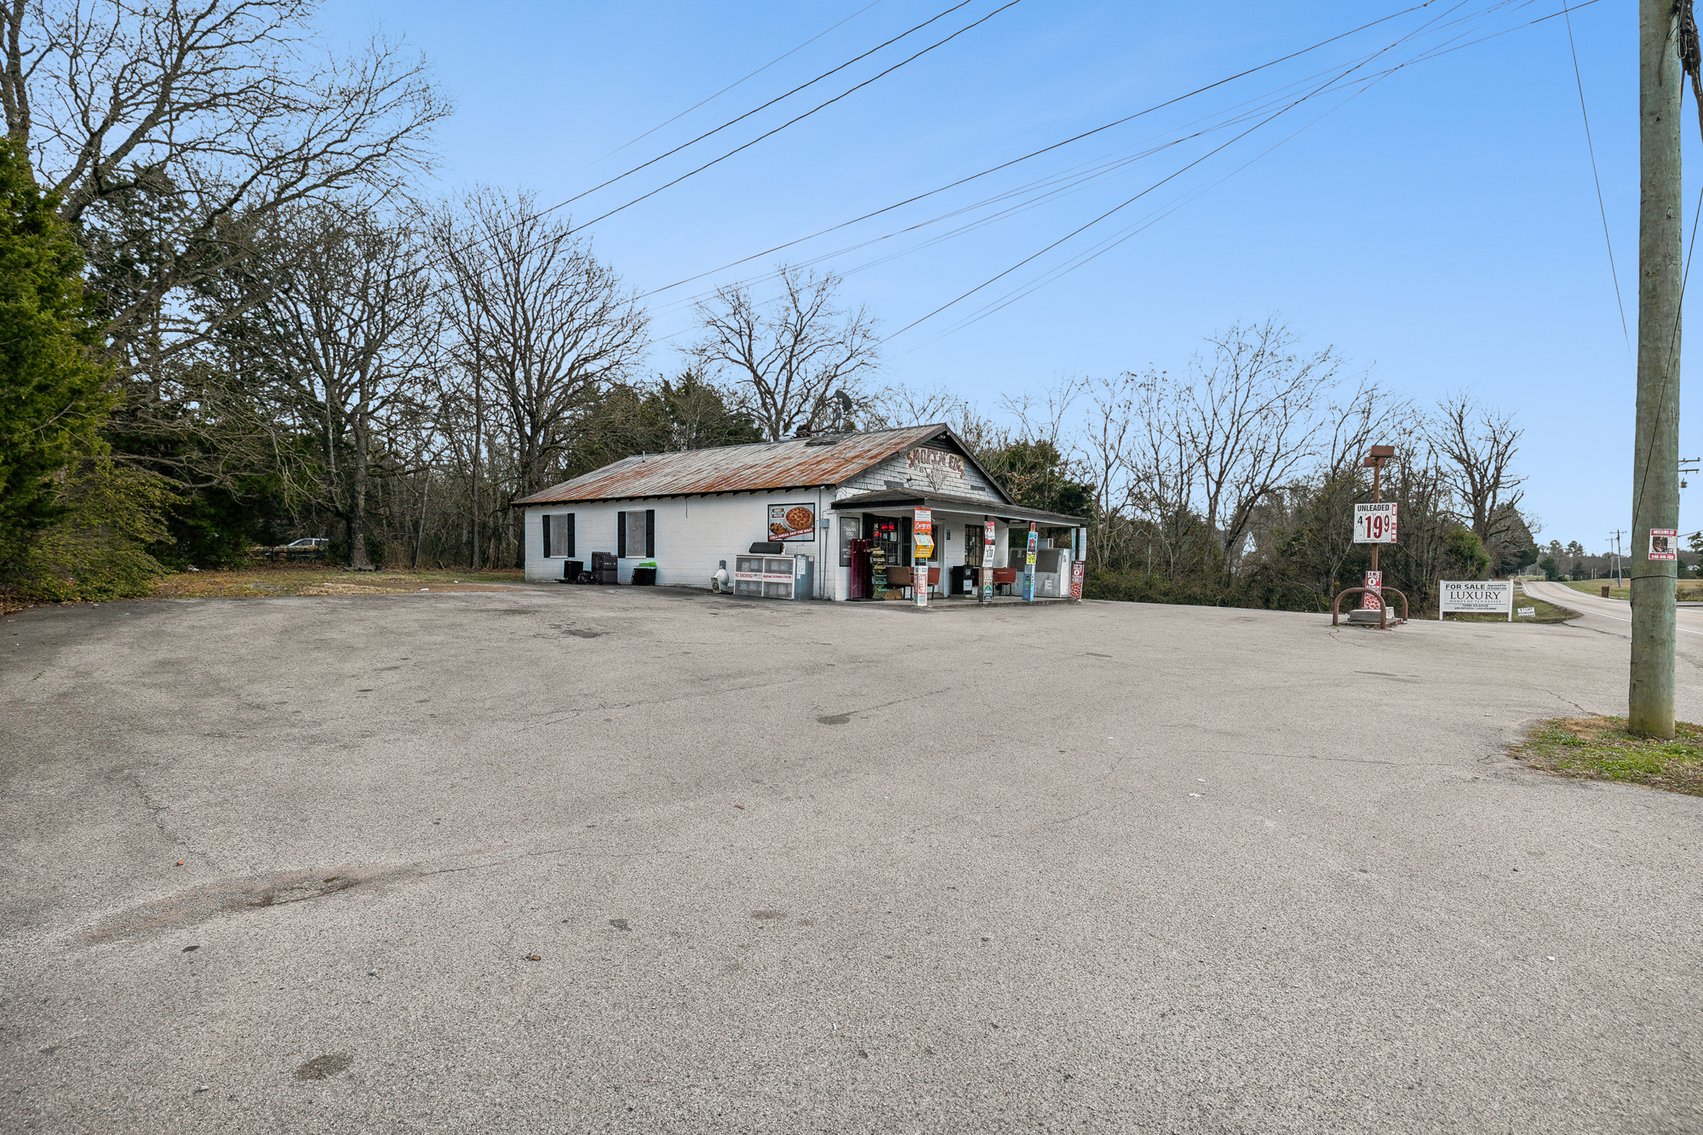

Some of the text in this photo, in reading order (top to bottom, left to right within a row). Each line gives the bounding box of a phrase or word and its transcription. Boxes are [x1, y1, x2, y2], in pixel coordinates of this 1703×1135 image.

[1357, 504, 1390, 512] UNLEADED
[1357, 515, 1363, 525] 4
[1365, 515, 1383, 539] 19
[1384, 514, 1390, 532] 9
[1450, 591, 1501, 600] LUXURY
